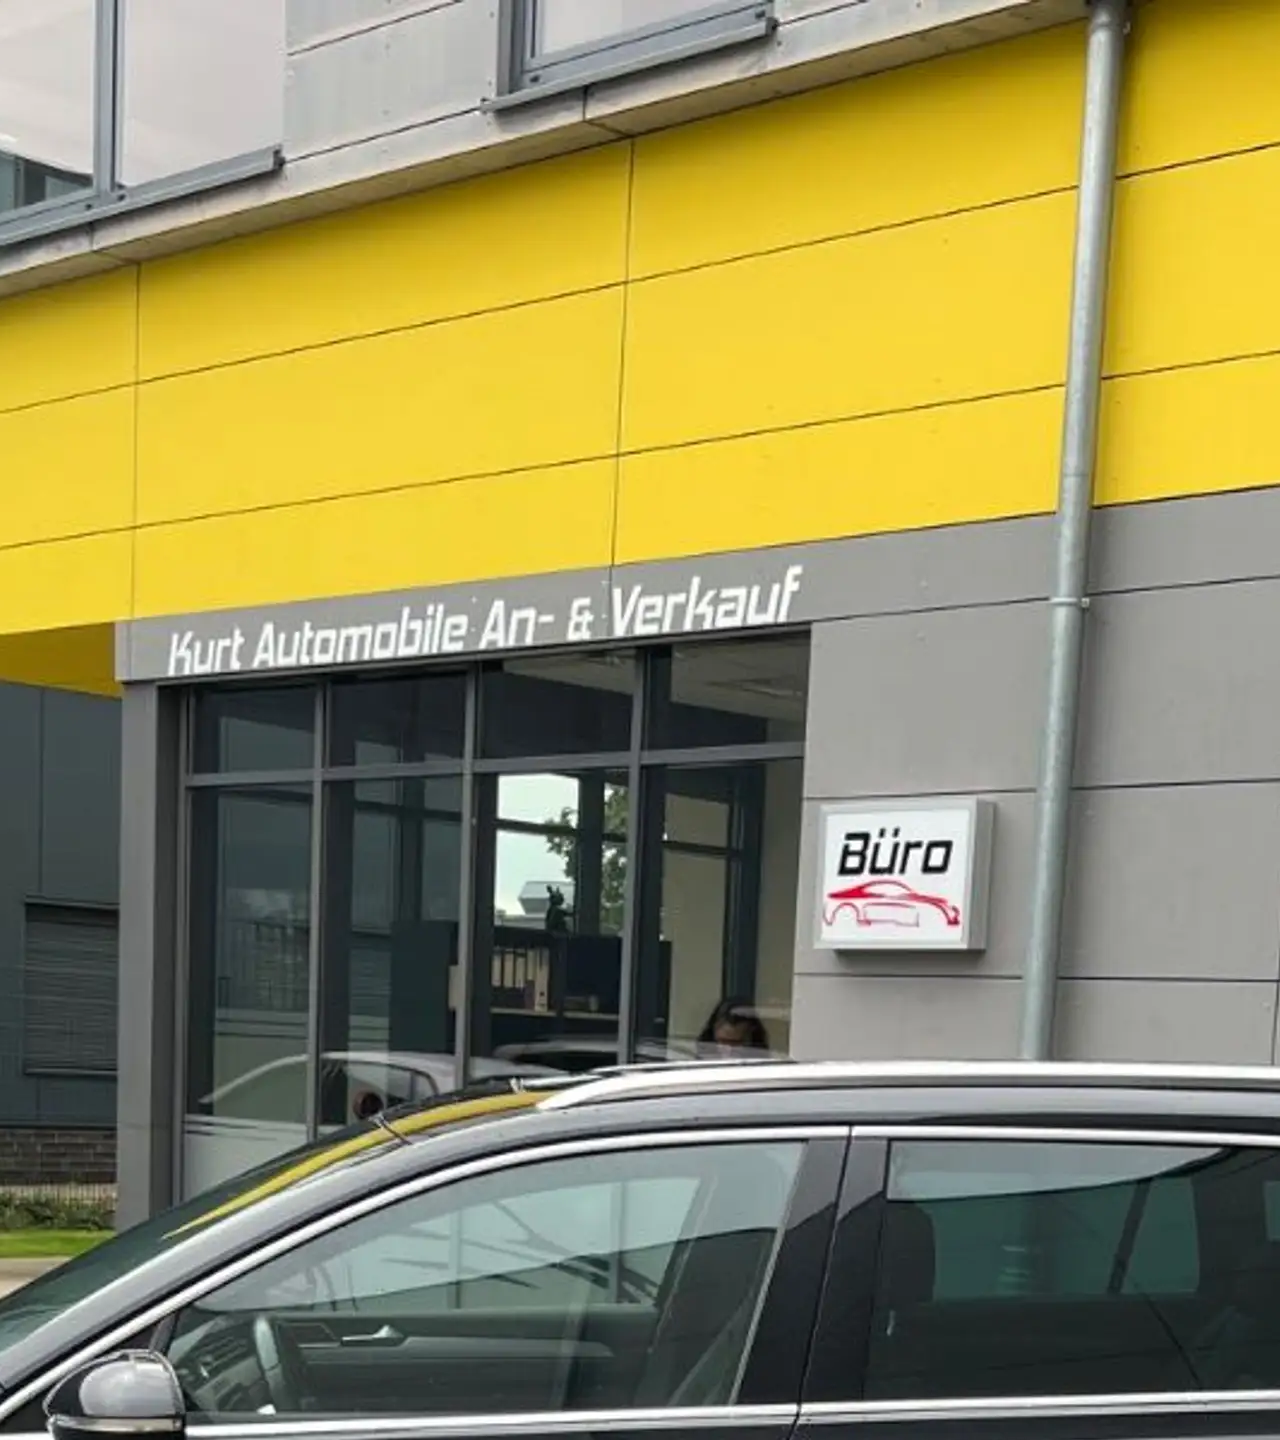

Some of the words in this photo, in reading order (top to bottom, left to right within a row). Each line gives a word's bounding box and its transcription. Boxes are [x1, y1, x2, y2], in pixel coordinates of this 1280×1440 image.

[166, 626, 246, 677] Kurt
[251, 602, 469, 669] Automobile
[477, 598, 555, 650] An-
[566, 596, 595, 642] &
[612, 564, 804, 638] Verkauf
[837, 826, 954, 876] Büro
